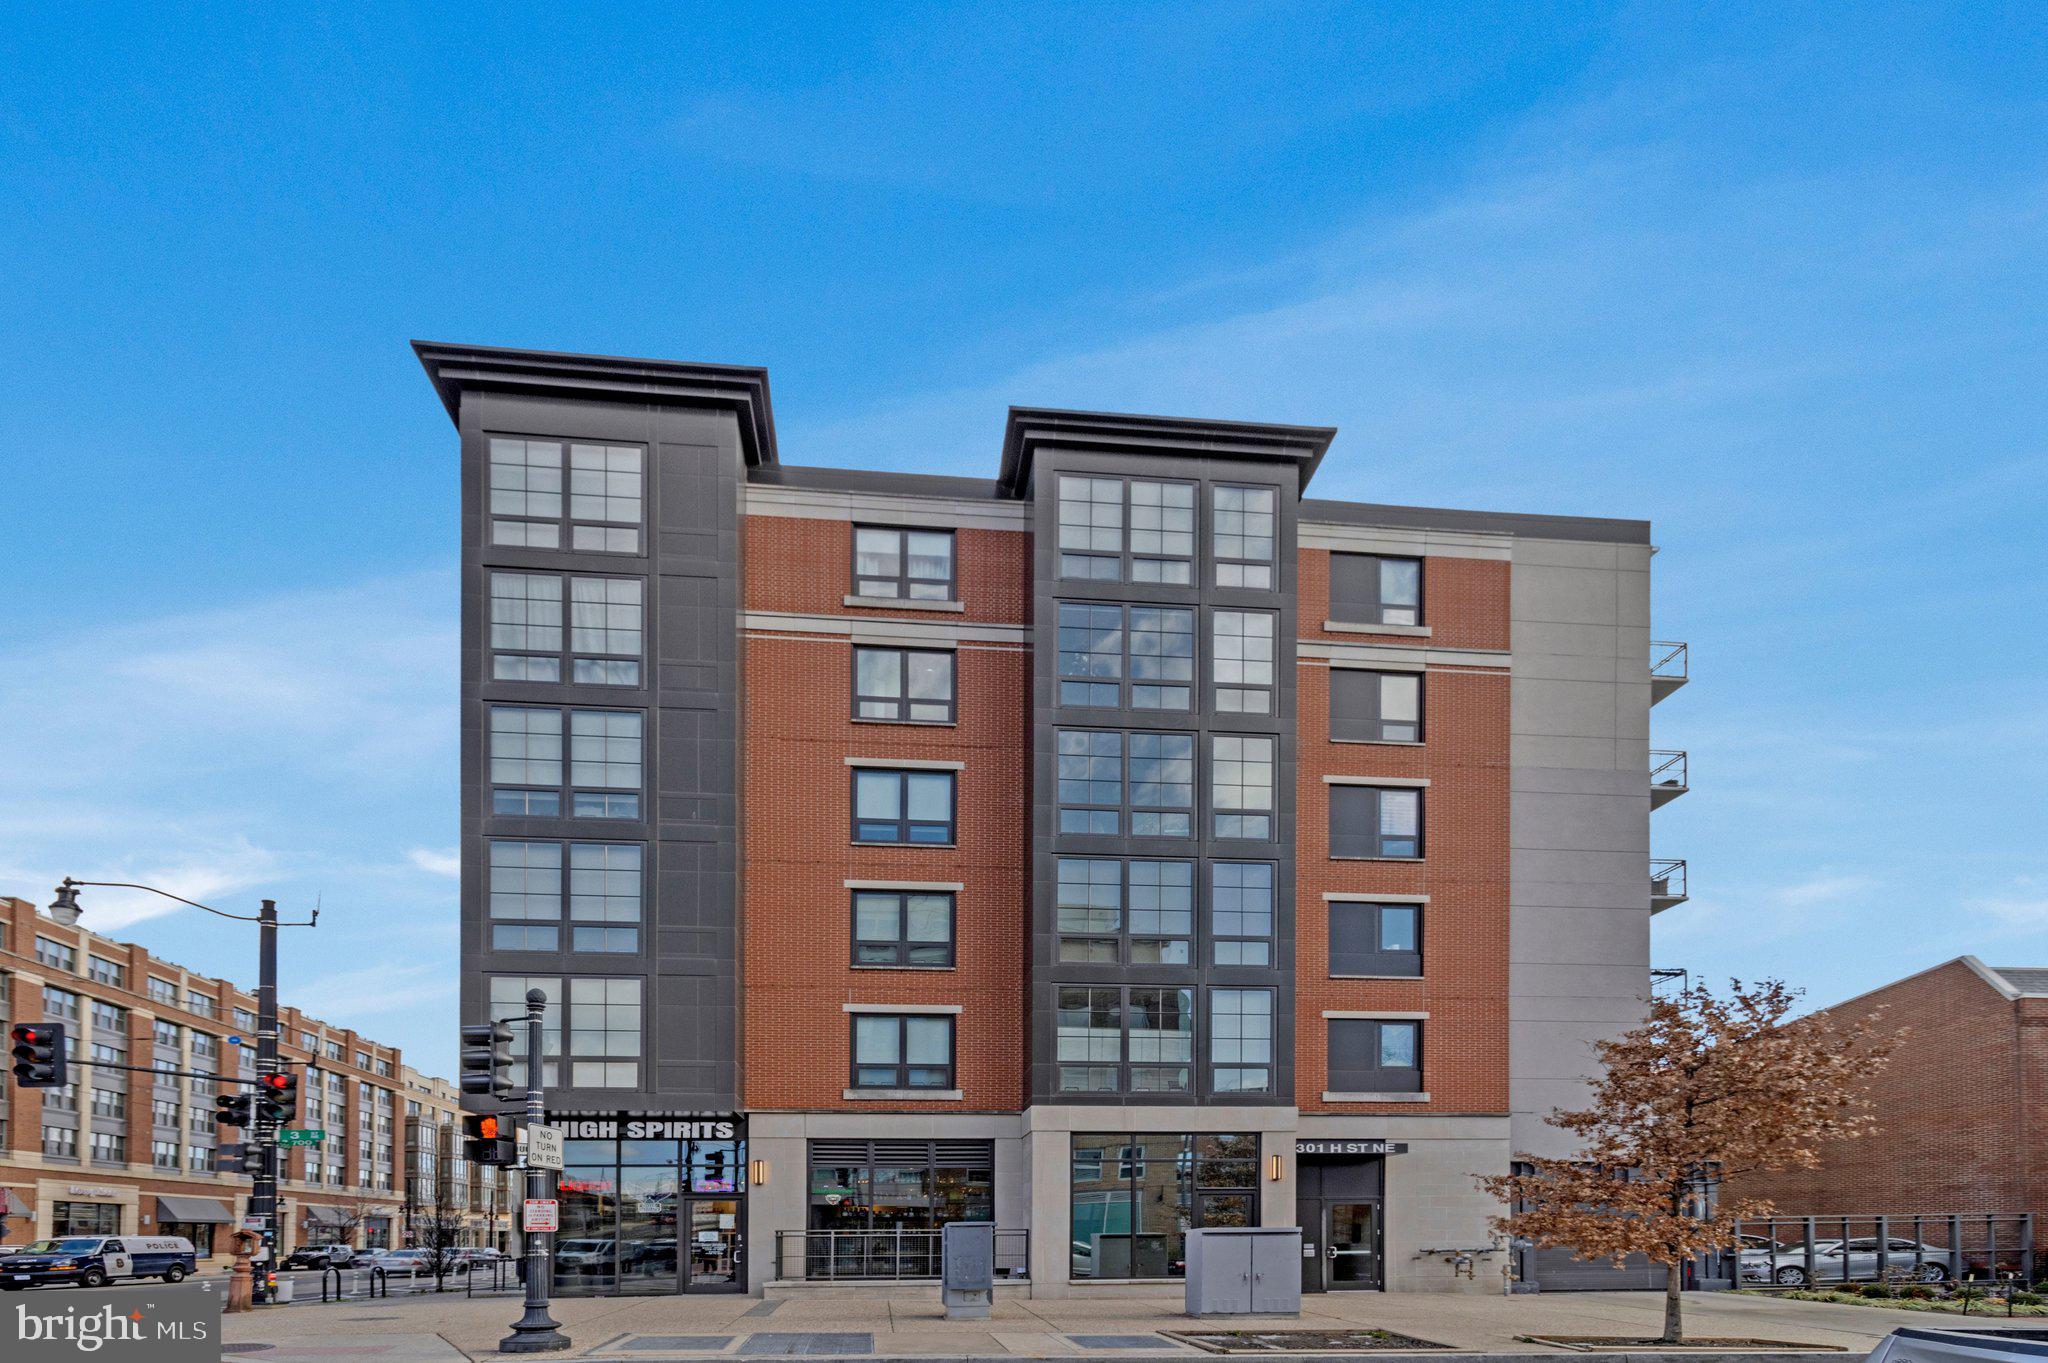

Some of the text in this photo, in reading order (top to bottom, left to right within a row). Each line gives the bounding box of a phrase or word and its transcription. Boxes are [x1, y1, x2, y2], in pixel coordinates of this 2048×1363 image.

[551, 1121, 734, 1138] HIGH SPIRITS
[290, 1131, 300, 1139] 3
[540, 1131, 552, 1140] NO
[536, 1141, 557, 1152] TURN
[1296, 1143, 1396, 1153] 301 H ST NE
[531, 1153, 561, 1165] ON RED
